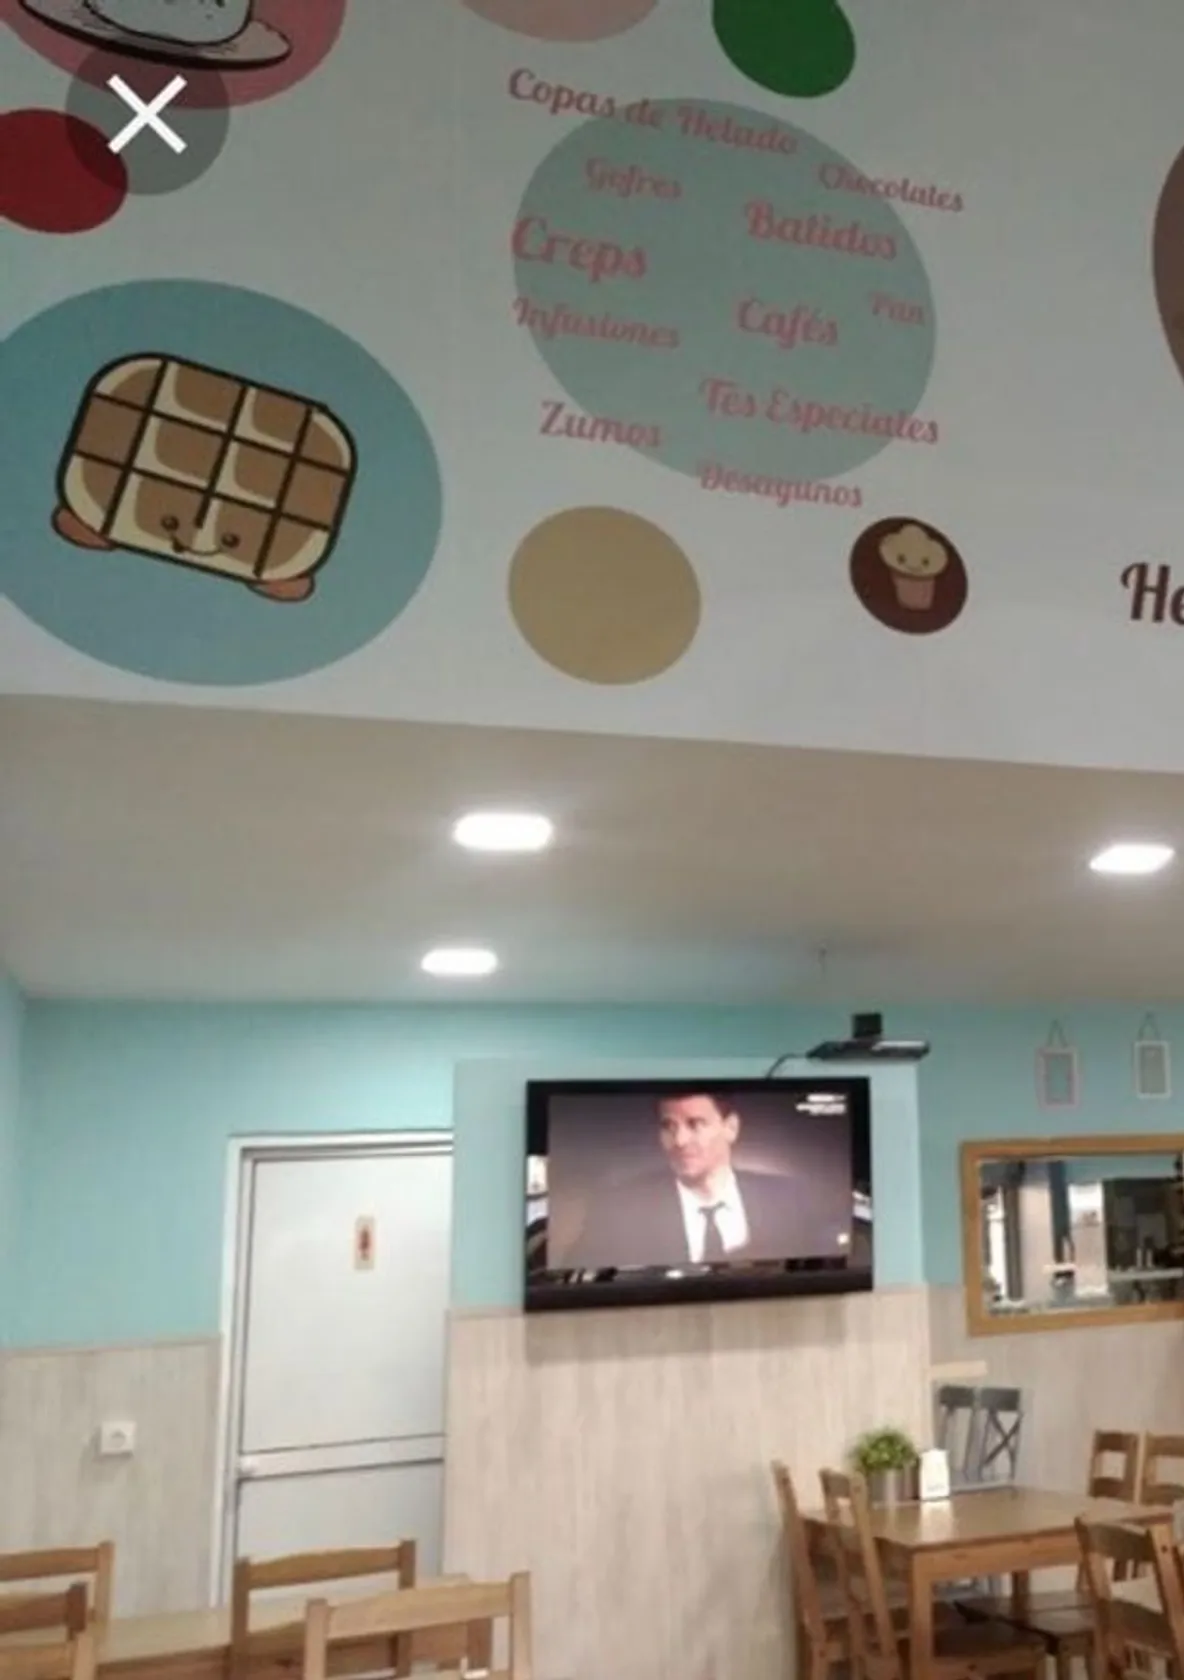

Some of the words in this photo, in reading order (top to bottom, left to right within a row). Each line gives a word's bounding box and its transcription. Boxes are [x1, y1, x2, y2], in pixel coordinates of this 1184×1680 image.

[508, 67, 615, 116] Copas
[625, 98, 663, 130] de
[676, 105, 798, 155] Helado
[585, 157, 682, 199] Gofres
[818, 162, 963, 212] Chocolates
[512, 215, 647, 283] Creps
[744, 198, 898, 260] Batidos
[512, 296, 681, 349] Infusiones
[738, 296, 839, 348] Cafés
[871, 292, 925, 326] Pan
[540, 401, 662, 448] Zumos
[765, 388, 939, 444] Especiales
[697, 460, 863, 508] Desayunos
